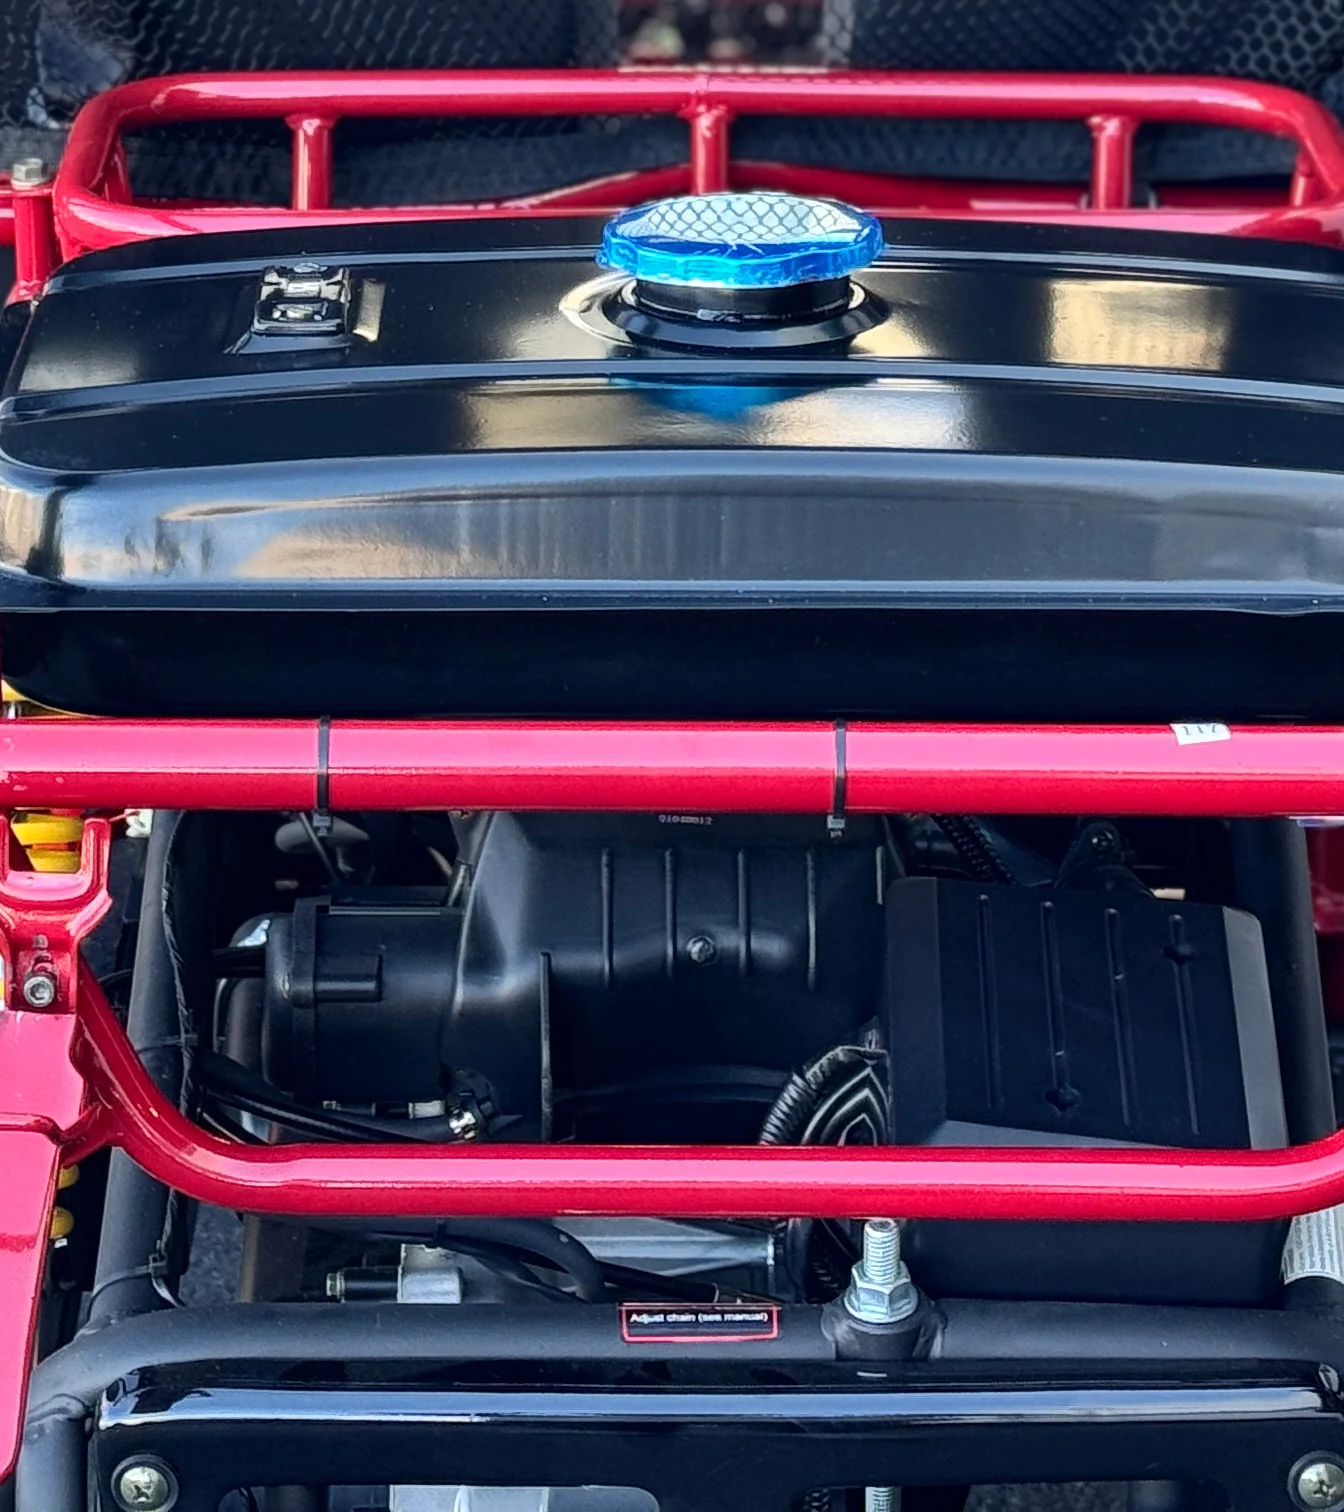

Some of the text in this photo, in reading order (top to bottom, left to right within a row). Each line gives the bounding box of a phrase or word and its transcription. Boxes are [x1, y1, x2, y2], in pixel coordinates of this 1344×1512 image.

[629, 1313, 665, 1325] Adjust
[665, 1312, 697, 1323] chain
[723, 1312, 769, 1323] manual)
